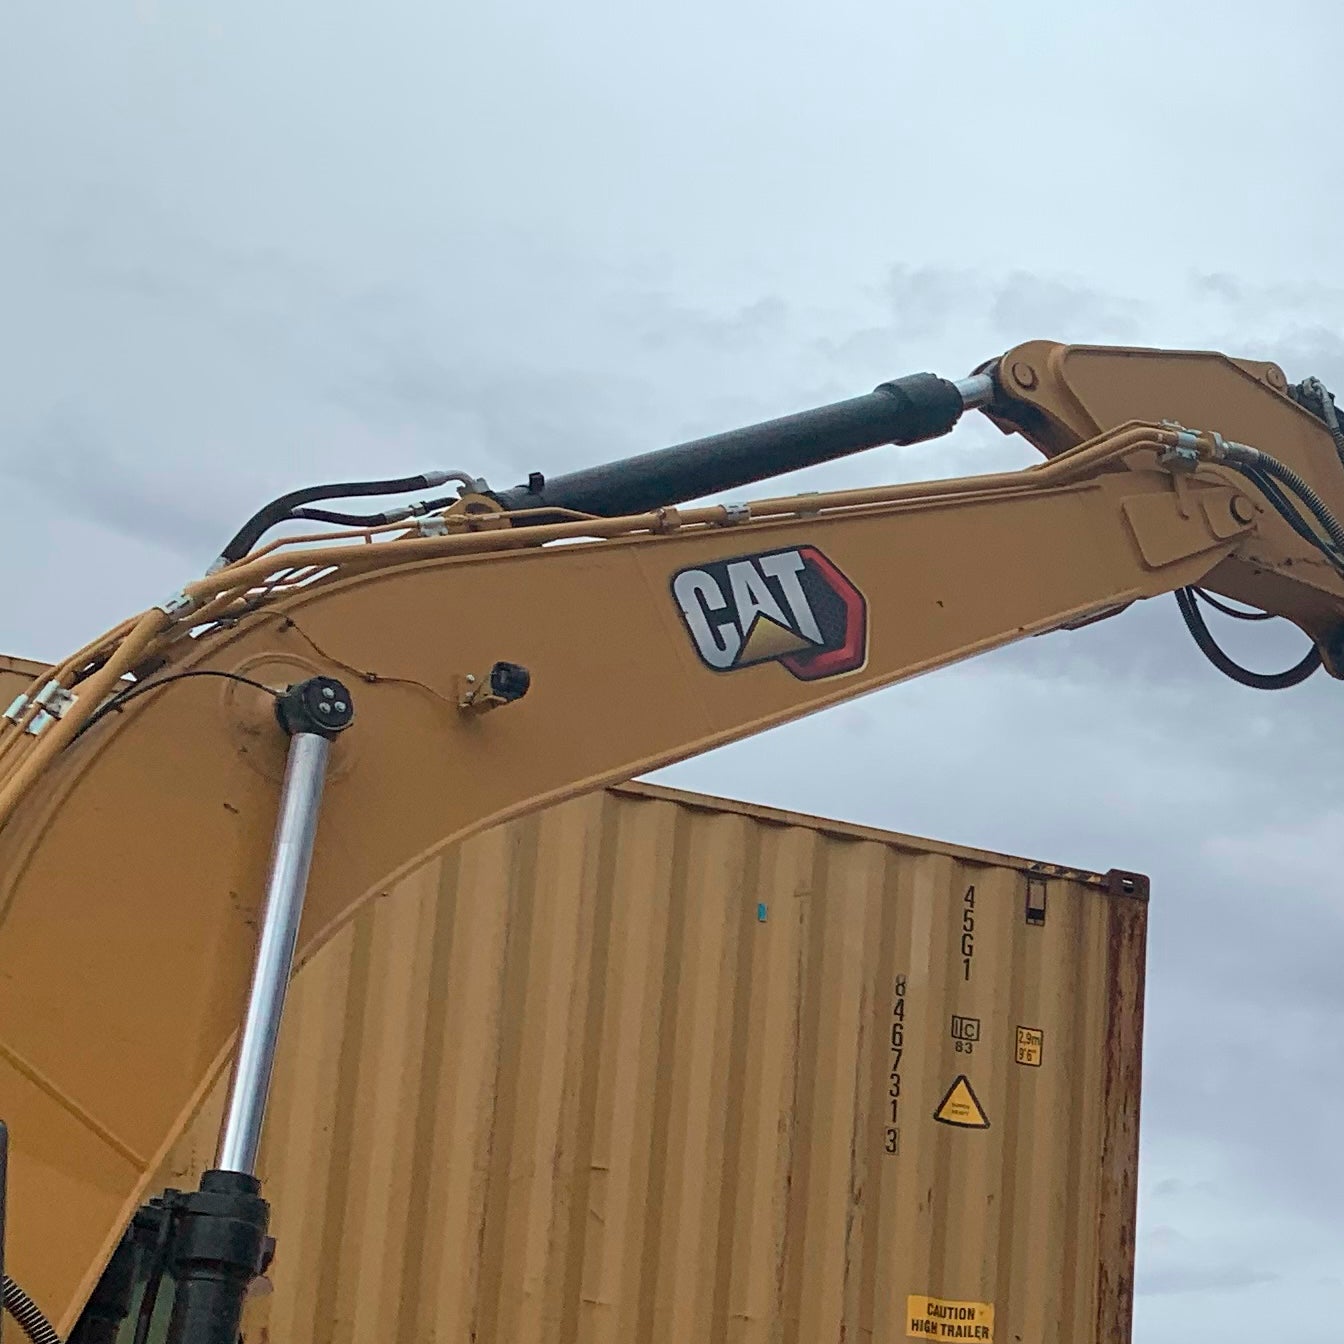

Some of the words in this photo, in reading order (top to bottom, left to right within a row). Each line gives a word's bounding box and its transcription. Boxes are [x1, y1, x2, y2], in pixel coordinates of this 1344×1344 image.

[673, 551, 825, 668] CAT
[961, 885, 975, 981] 45G1
[955, 1041, 973, 1054] 83
[927, 1303, 976, 1320] CAUTION
[911, 1319, 937, 1335] HIGH
[940, 1324, 989, 1339] TRAILER
